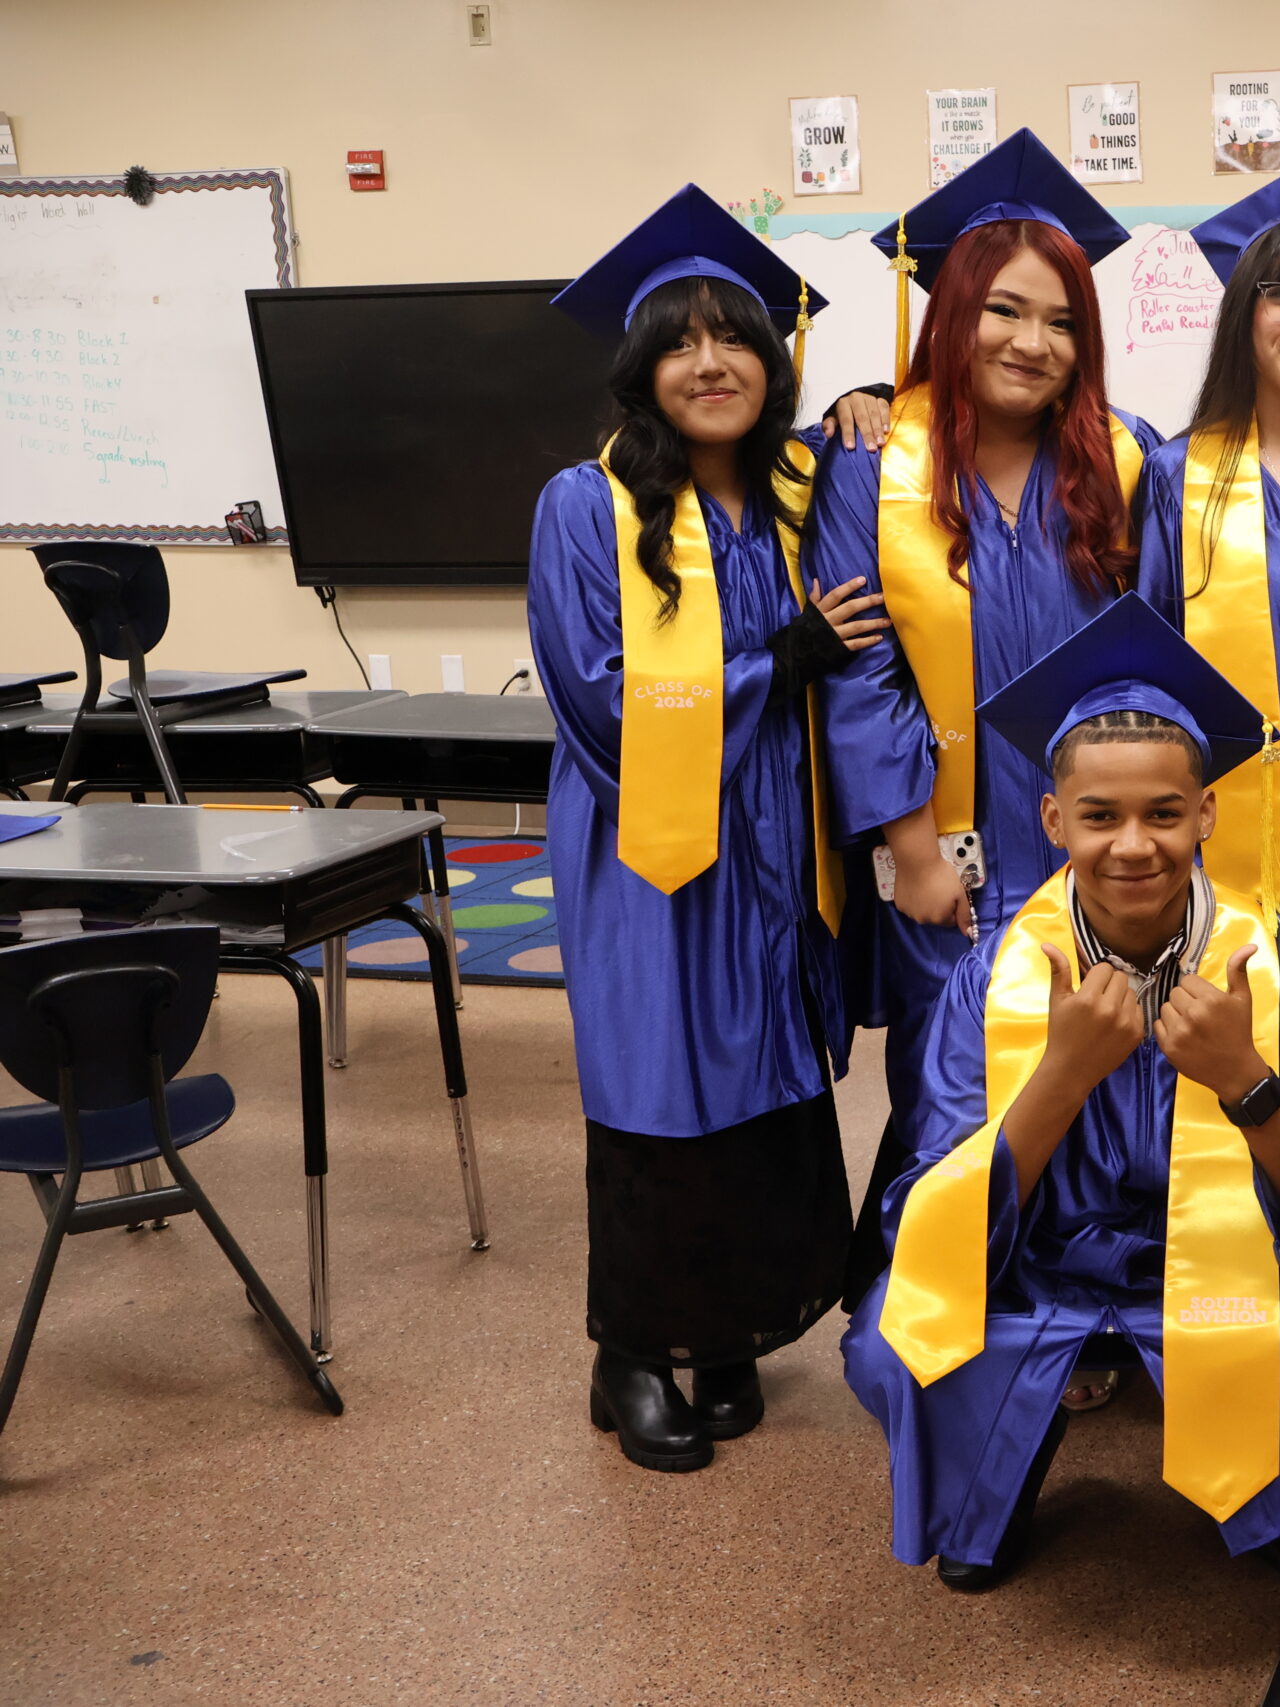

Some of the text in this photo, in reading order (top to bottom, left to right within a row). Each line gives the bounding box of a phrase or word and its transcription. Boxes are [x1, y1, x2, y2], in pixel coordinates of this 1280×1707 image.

[1229, 82, 1269, 96] ROOTING
[935, 96, 988, 109] YOUR BRAIN
[1241, 99, 1258, 112] FOR
[941, 120, 984, 132] IT GROWS
[1109, 112, 1136, 126] GOOD
[1239, 116, 1260, 128] YOU!
[803, 126, 847, 146] GROW.
[1100, 134, 1137, 149] THINGS
[933, 142, 991, 155] CHALLENGE IT
[1084, 157, 1137, 171] TAKE TIME.
[1140, 297, 1170, 318] Roller
[78, 329, 113, 347] Block
[120, 332, 129, 345] 1
[79, 351, 108, 366] Block
[112, 353, 121, 366] 2
[634, 681, 713, 699] CLASS OF
[655, 696, 695, 708] 2026
[946, 729, 967, 743] OF
[1190, 1296, 1258, 1310] SOUTH
[1179, 1309, 1268, 1324] DIVISION
